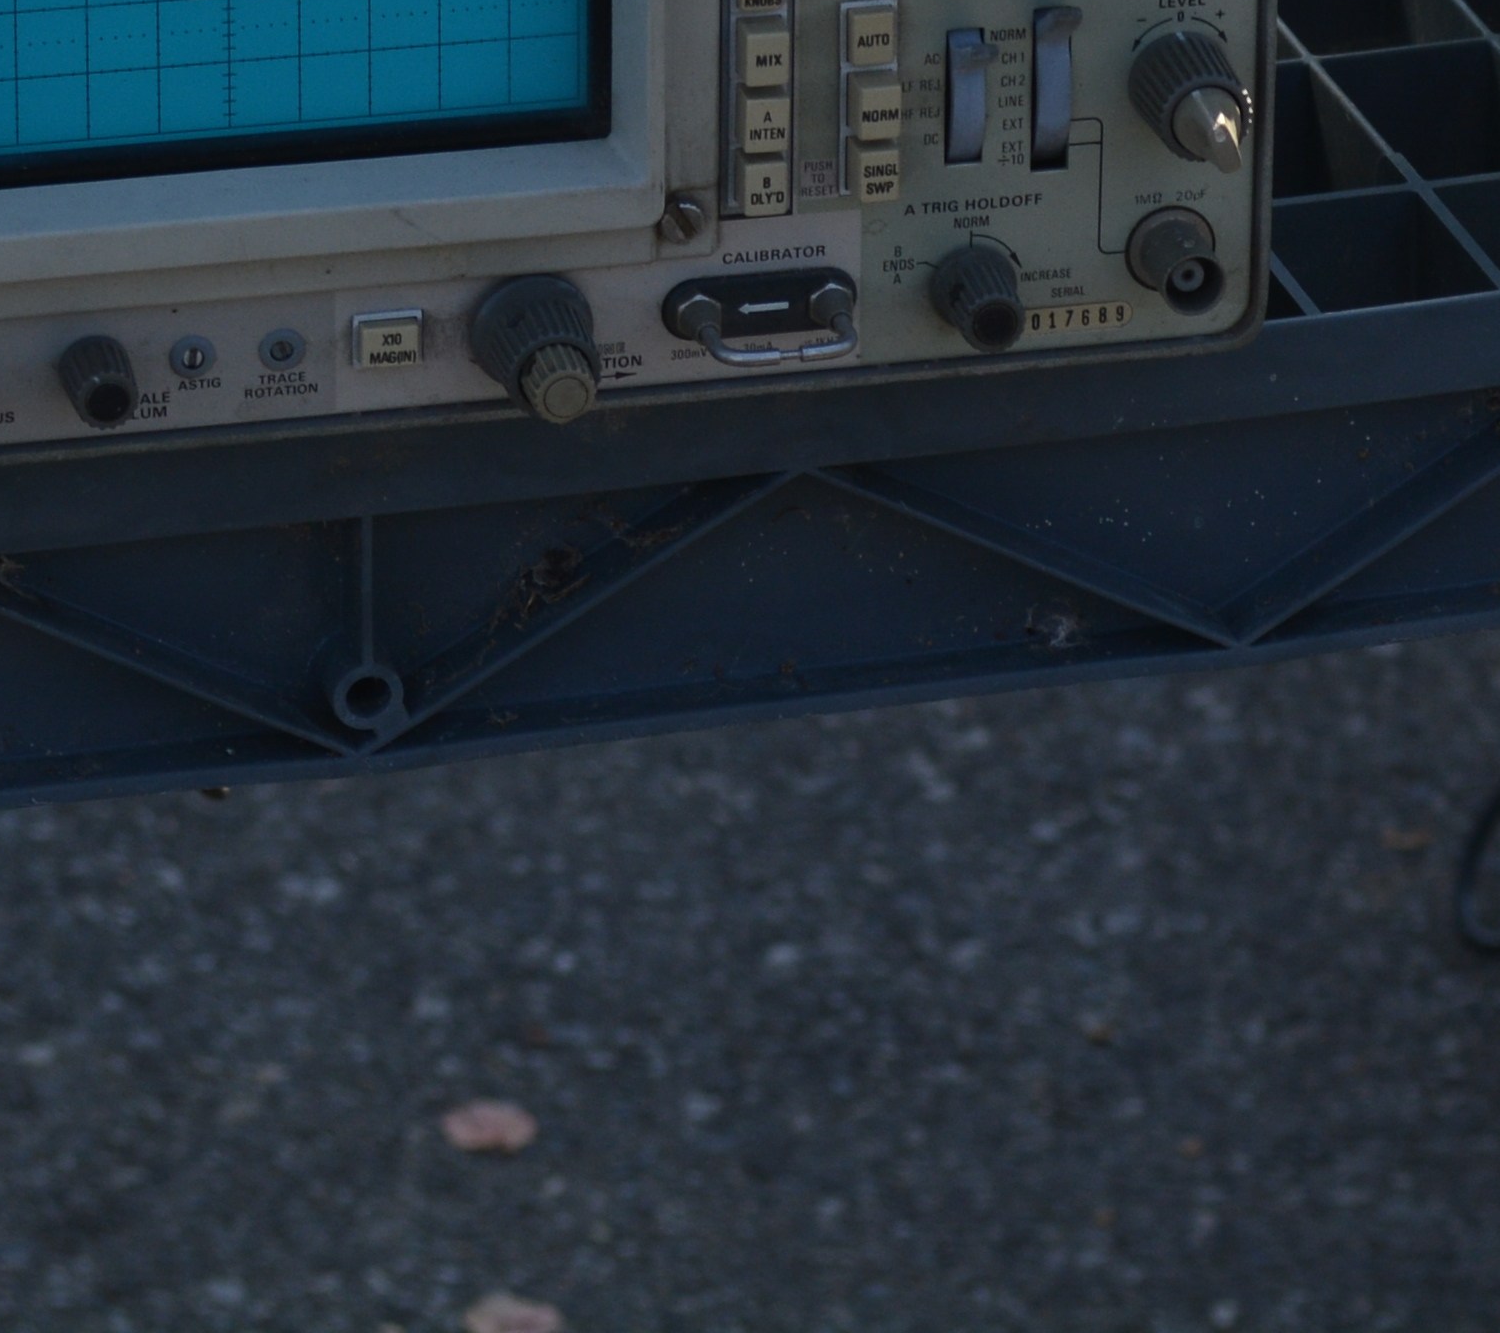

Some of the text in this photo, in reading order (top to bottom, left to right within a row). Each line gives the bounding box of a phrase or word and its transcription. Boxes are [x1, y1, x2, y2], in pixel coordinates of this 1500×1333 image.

[857, 33, 890, 47] AUTO
[756, 54, 782, 67] MIX
[862, 108, 899, 122] NORM
[750, 127, 785, 140] INTEN
[904, 193, 1043, 216] A TRIG HOLDOFF
[953, 215, 989, 229] NORM
[722, 244, 826, 265] CALIBRATOR
[1020, 268, 1072, 282] INCREASE
[178, 377, 221, 392] ASTIG
[259, 371, 307, 386] TRACE
[244, 383, 319, 399] ROTATION
